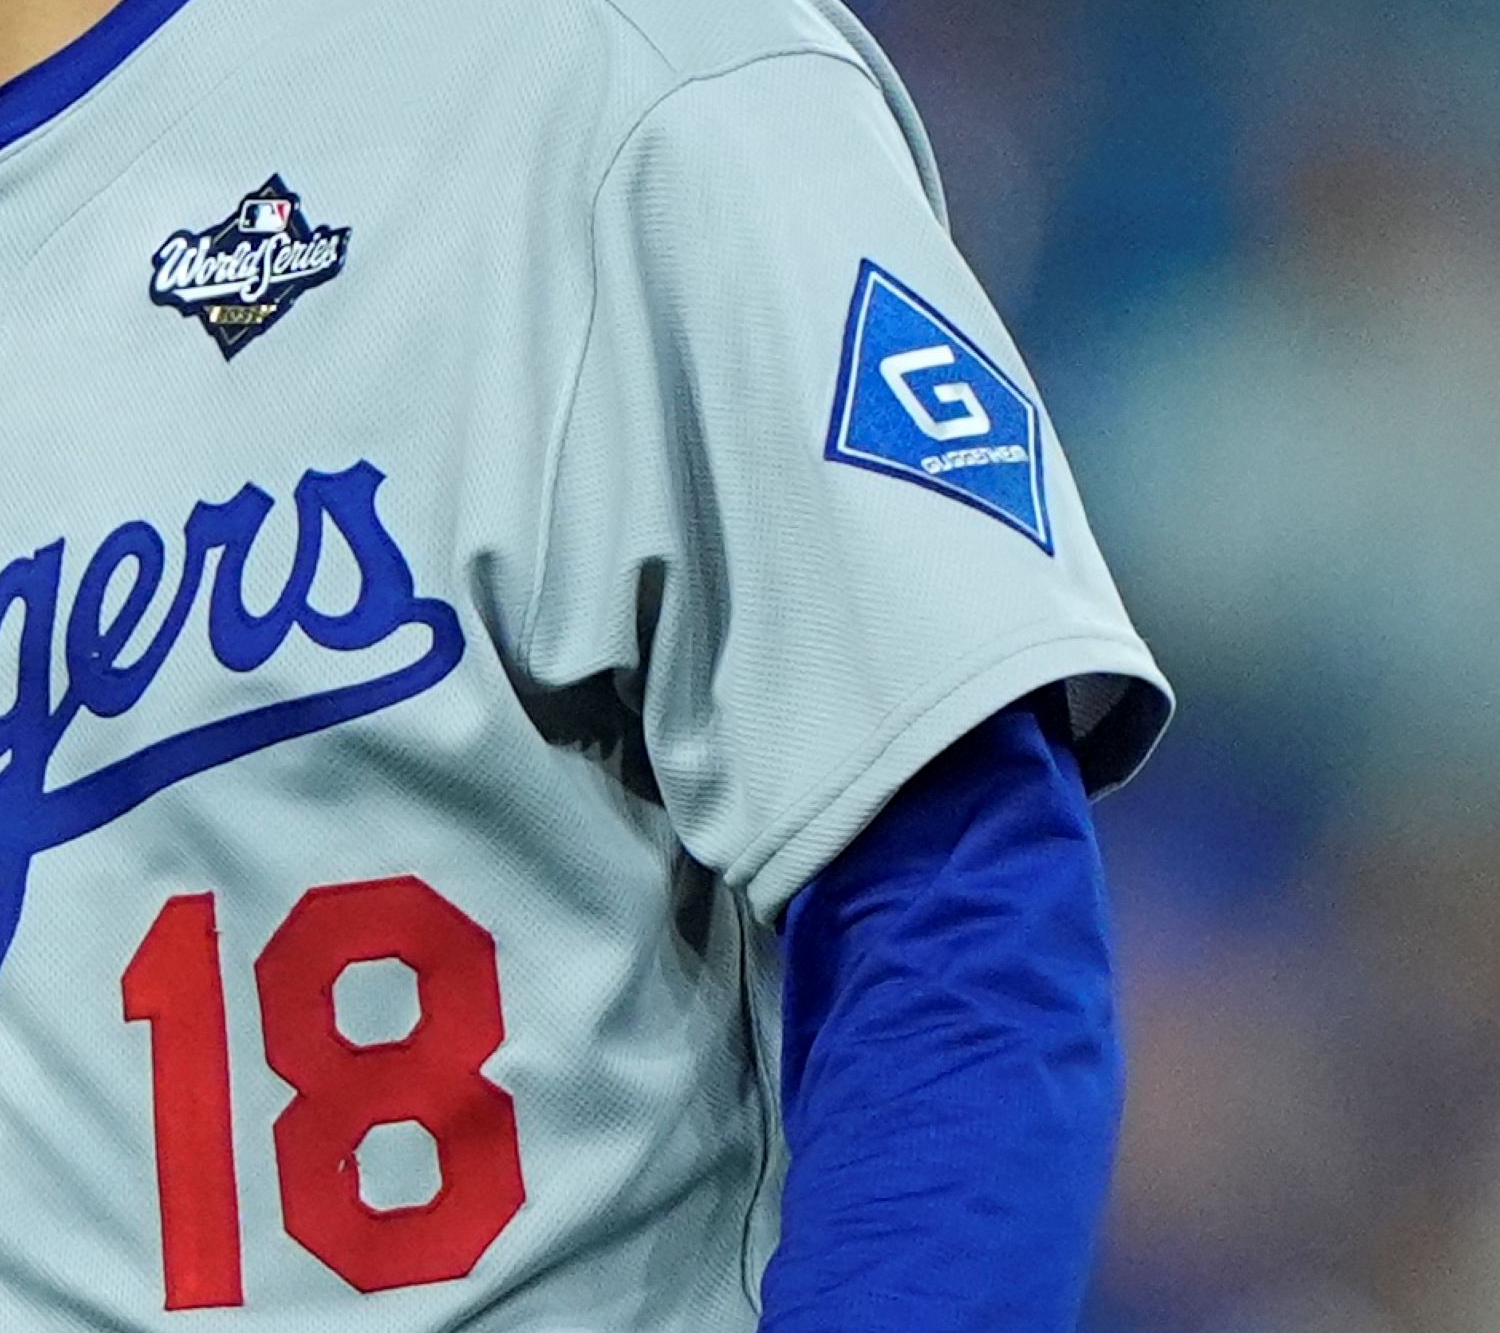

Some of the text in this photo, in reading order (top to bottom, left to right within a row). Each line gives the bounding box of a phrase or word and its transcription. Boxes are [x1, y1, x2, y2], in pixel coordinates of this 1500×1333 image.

[155, 232, 340, 302] World Series
[879, 344, 992, 442] G
[120, 875, 527, 1313] 18
